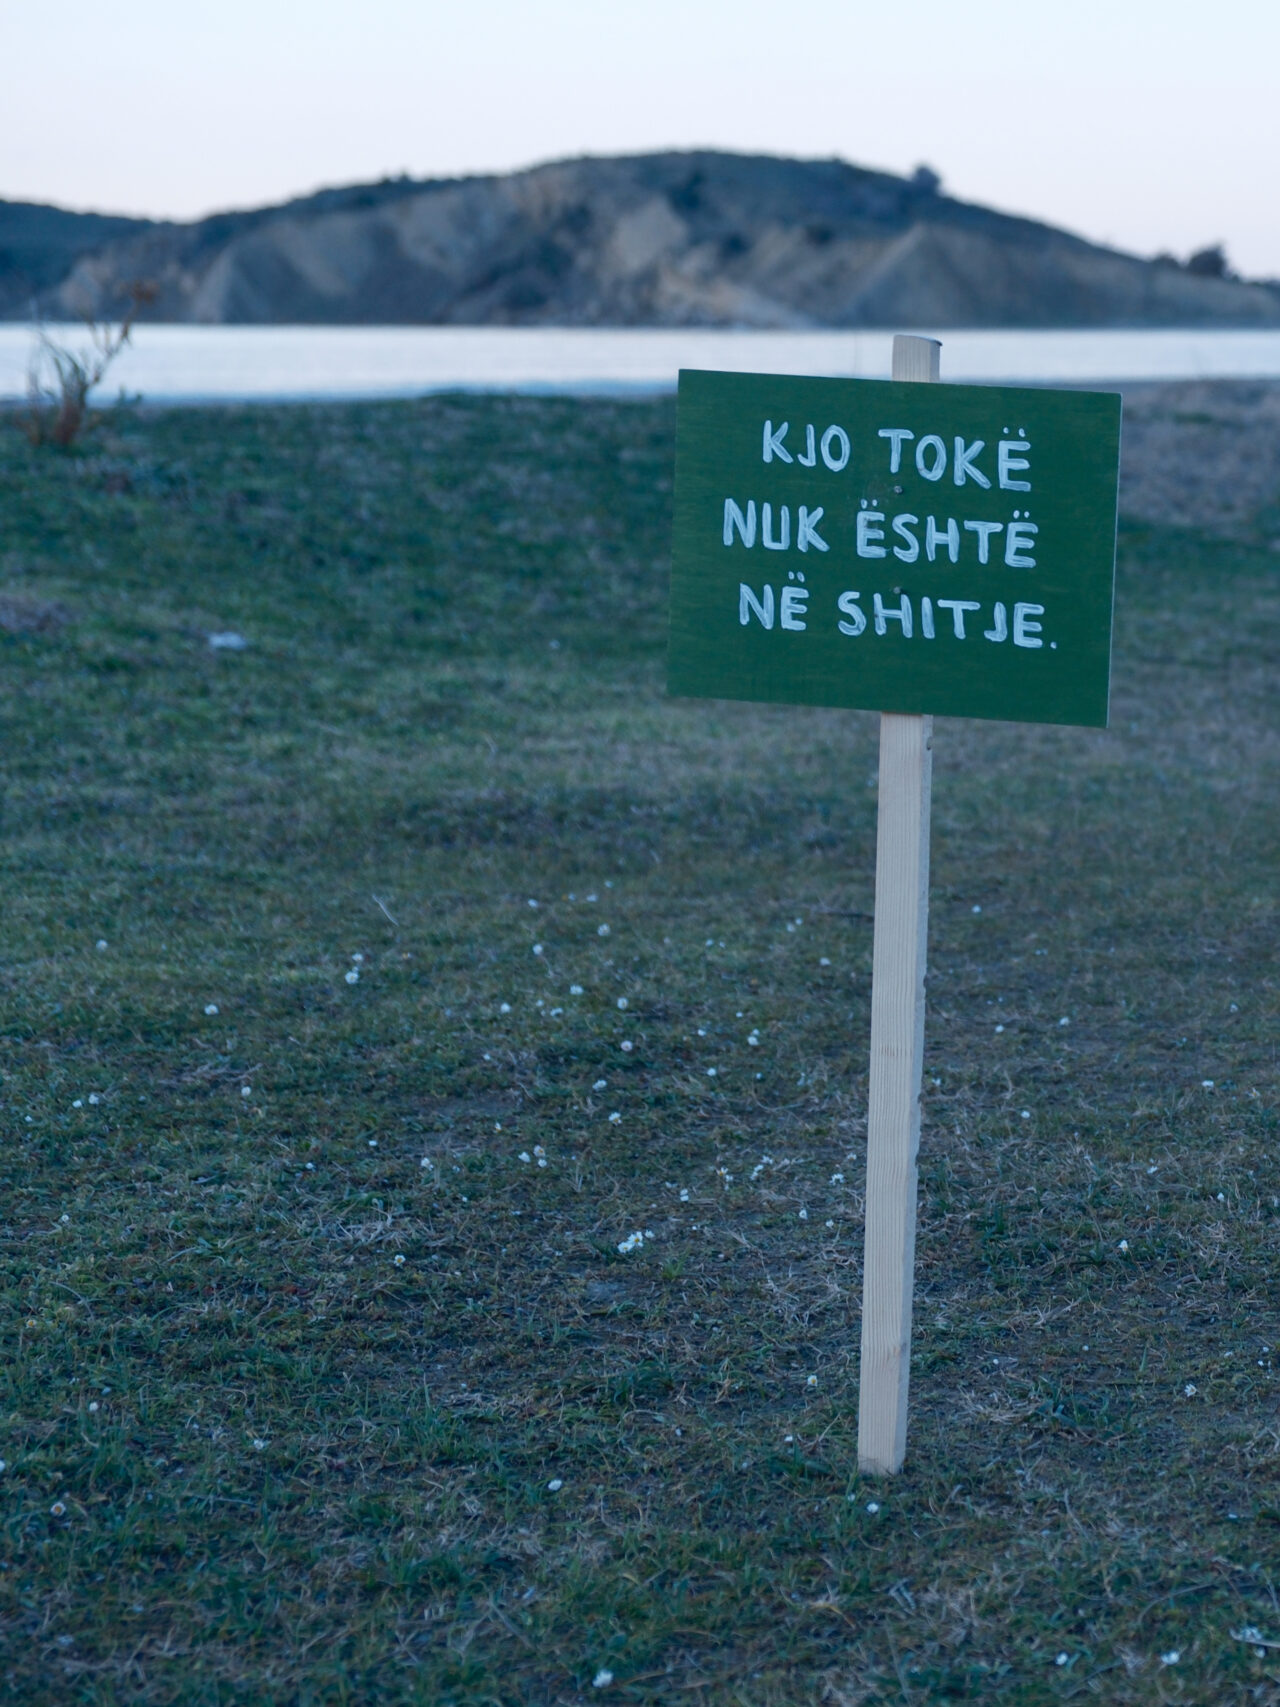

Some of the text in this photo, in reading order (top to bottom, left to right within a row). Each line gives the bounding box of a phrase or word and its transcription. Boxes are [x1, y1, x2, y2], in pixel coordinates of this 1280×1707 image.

[763, 420, 1032, 492] KJO TOKË
[723, 497, 1038, 568] NUK ËSHTË
[739, 571, 1057, 649] NË SHITJE.
